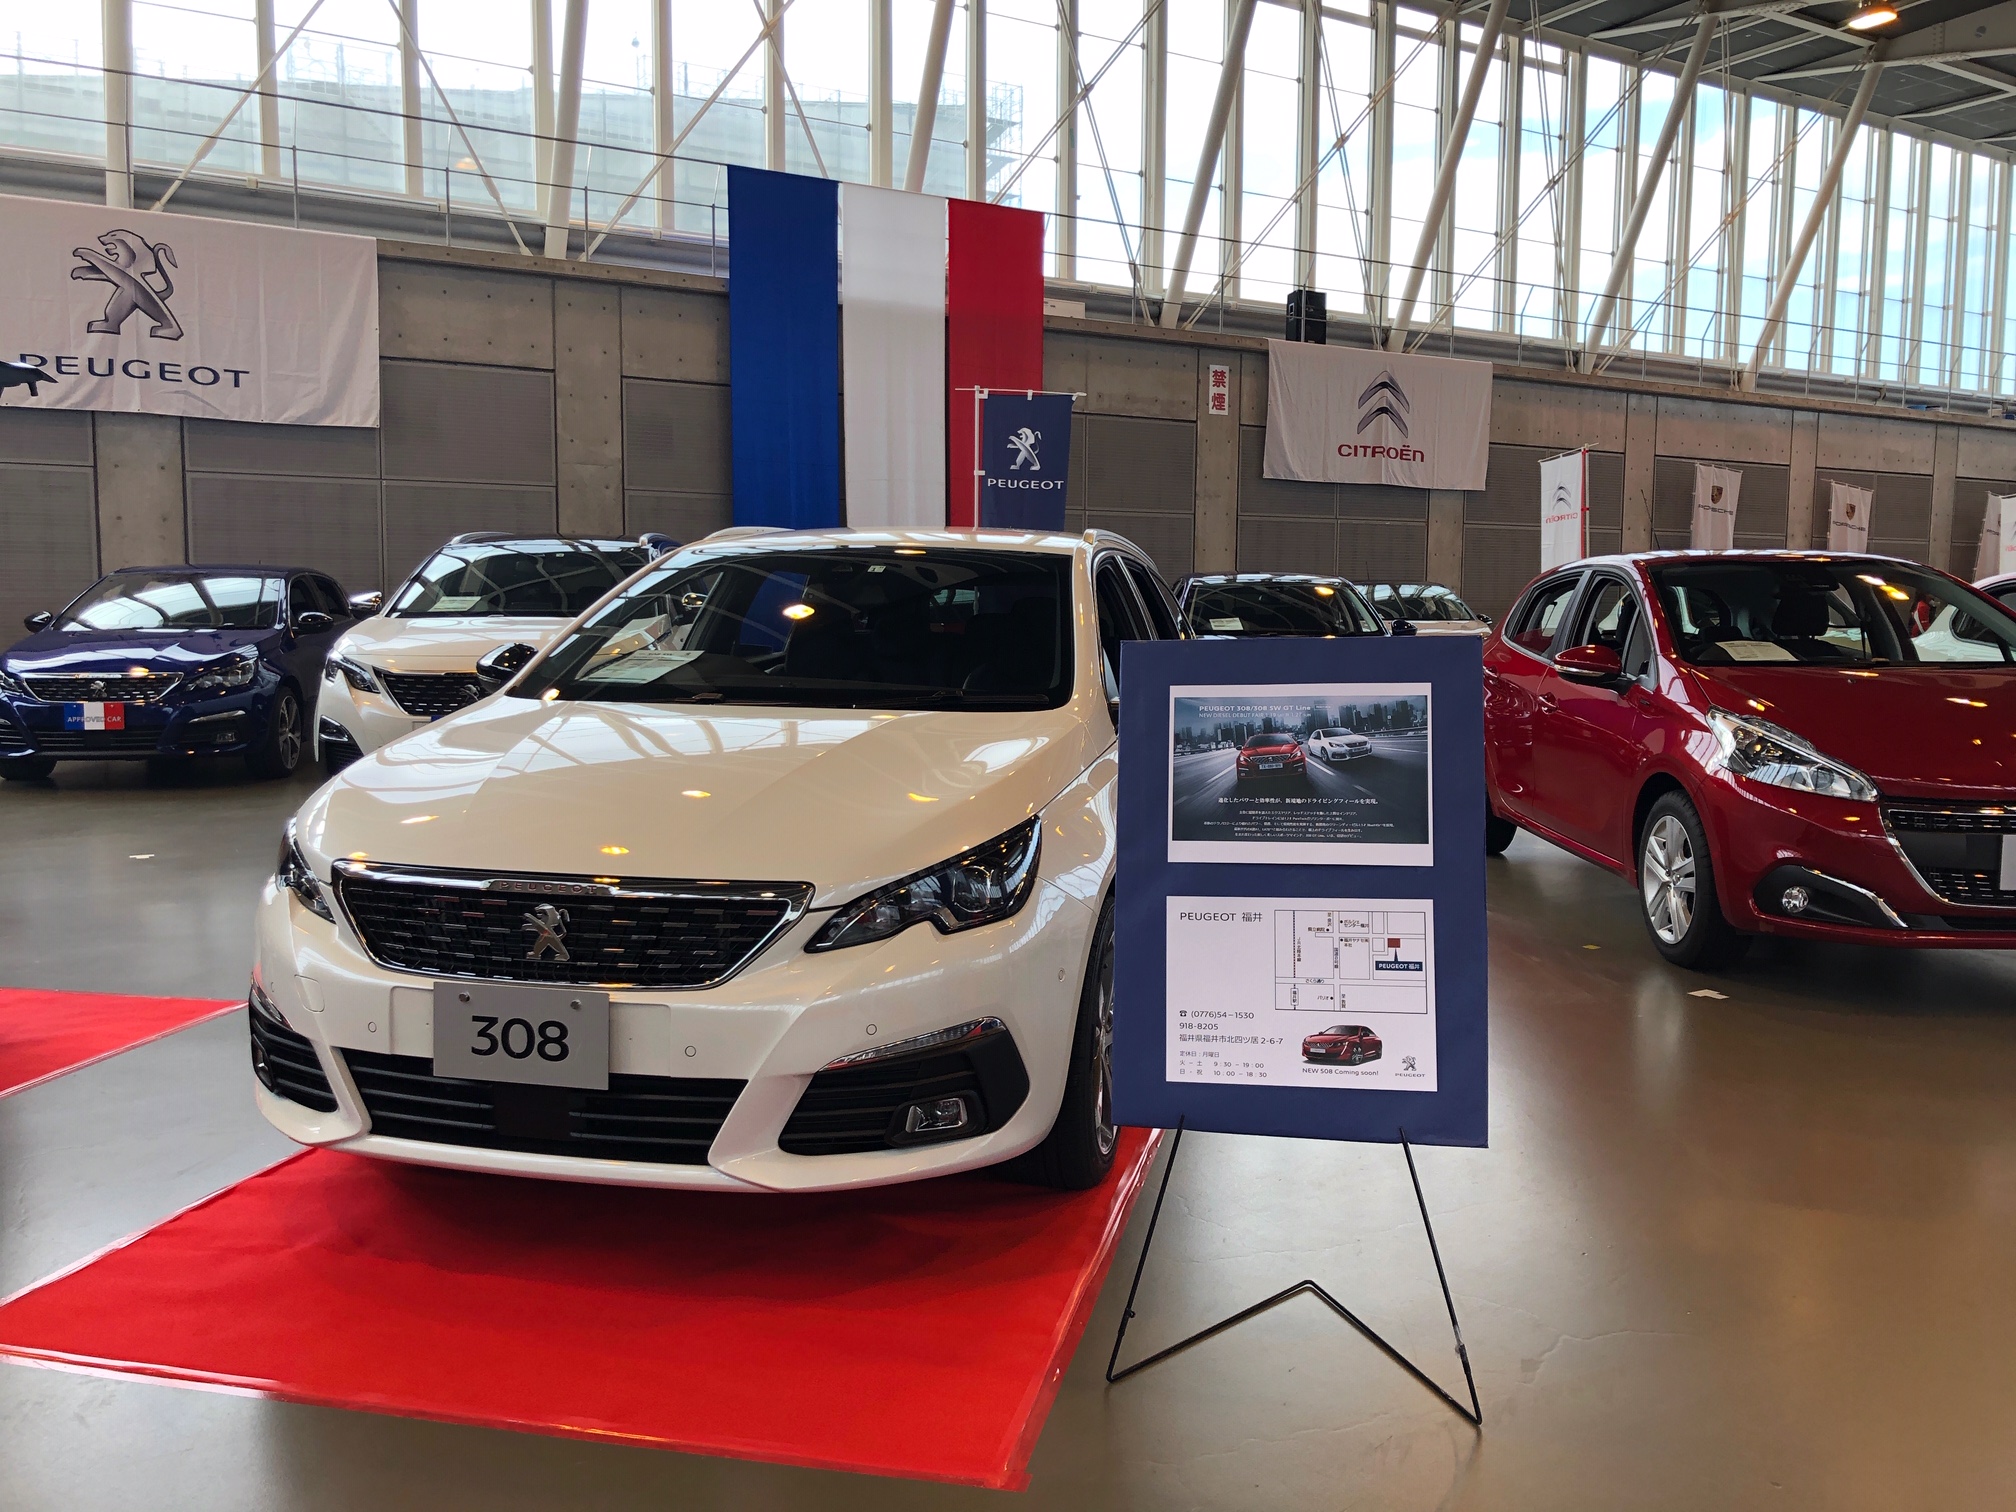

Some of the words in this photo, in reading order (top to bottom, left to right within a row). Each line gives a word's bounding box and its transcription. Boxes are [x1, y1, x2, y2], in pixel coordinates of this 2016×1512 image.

[20, 353, 250, 388] PEUGEOT
[1212, 369, 1227, 411] 禁煙
[987, 478, 1064, 490] PEUGEOT
[501, 882, 597, 894] PEUGEOT
[1180, 912, 1237, 921] PEUGEOT
[1242, 912, 1263, 922] 福井
[1179, 1022, 1219, 1030] 918-8205
[471, 1015, 570, 1062] 308
[1260, 1037, 1284, 1045] 2-6-7
[1334, 1069, 1360, 1077] Coming
